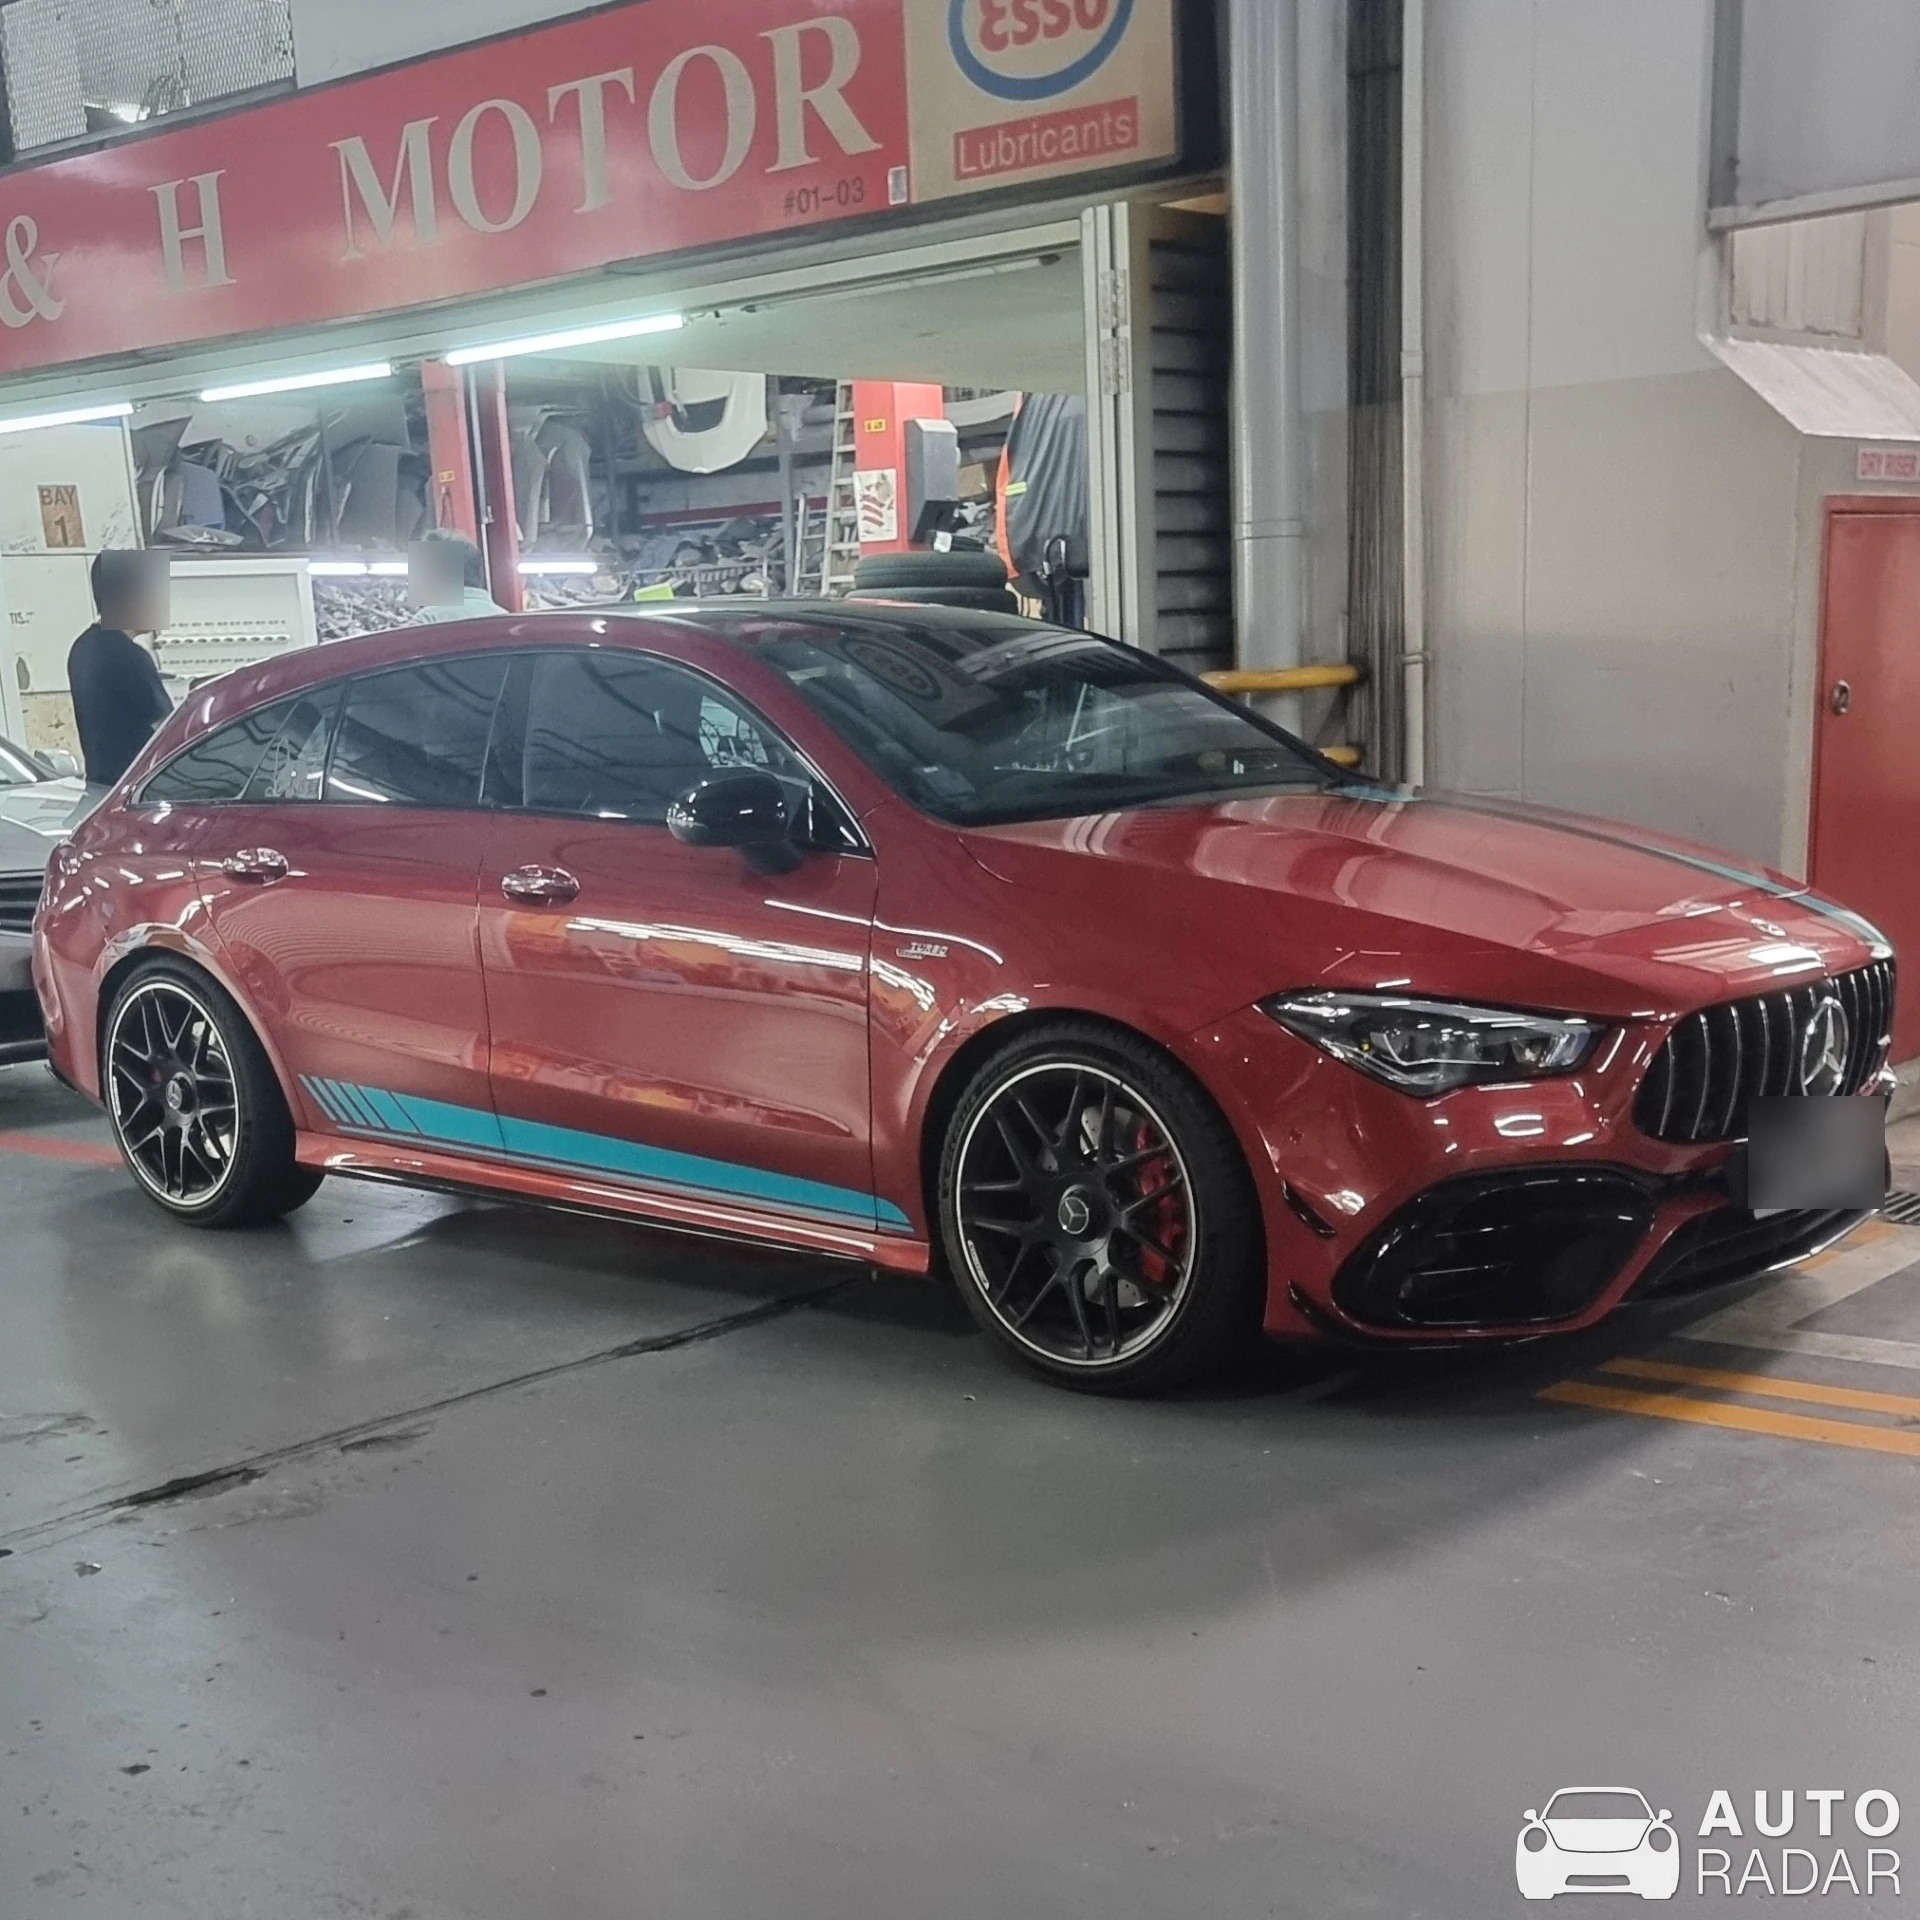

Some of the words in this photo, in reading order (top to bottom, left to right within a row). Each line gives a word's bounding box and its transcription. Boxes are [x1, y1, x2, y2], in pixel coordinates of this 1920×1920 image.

[958, 111, 1134, 173] Lubricants
[0, 214, 61, 329] &
[147, 168, 237, 292] H
[327, 14, 883, 262] MOTOR
[784, 176, 866, 217] #01-03
[39, 486, 77, 506] BAY
[54, 515, 69, 546] 1
